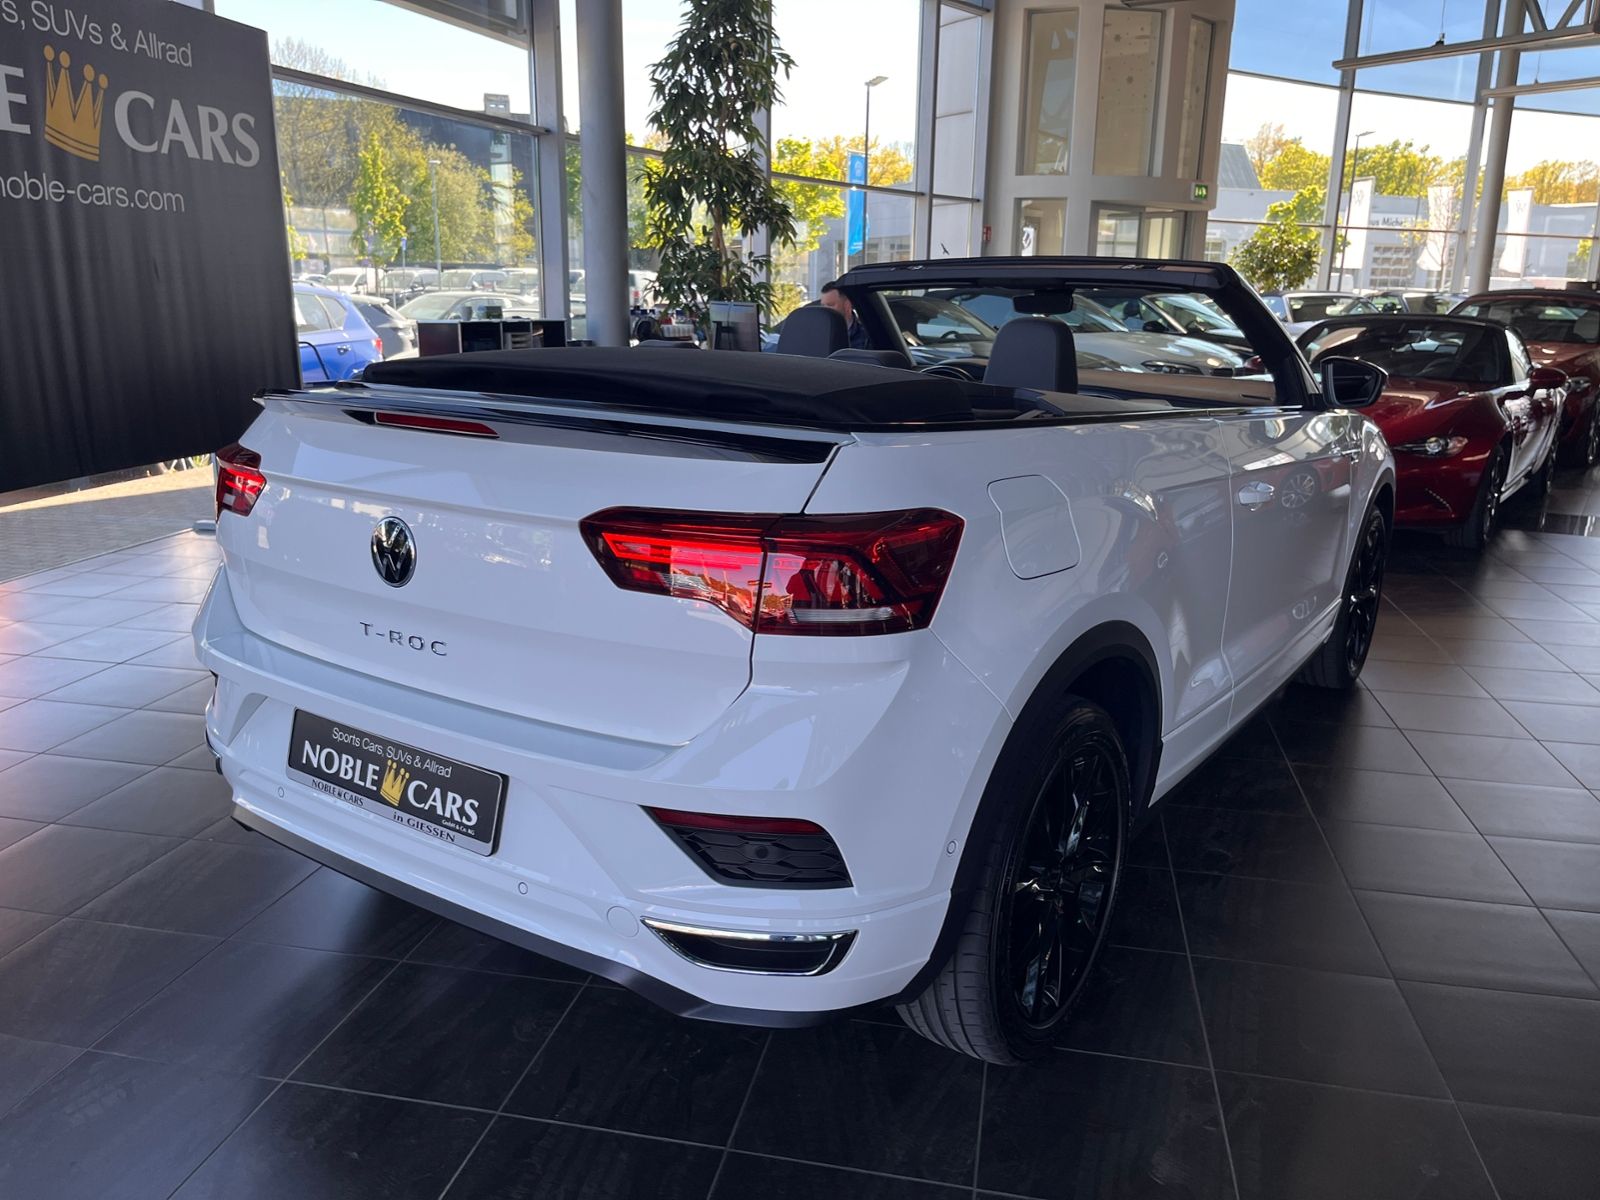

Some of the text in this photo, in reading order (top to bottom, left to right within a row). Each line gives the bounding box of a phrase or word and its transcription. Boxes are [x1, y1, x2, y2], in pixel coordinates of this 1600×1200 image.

[31, 0, 103, 45] SUVs
[110, 22, 129, 52] &
[134, 29, 192, 68] Allrad
[114, 90, 260, 168] CARS
[360, 621, 448, 656] T-ROC
[332, 727, 452, 778] Sports Cars, SUVs & Allrad
[302, 740, 479, 826] NOBLE CARS
[311, 779, 364, 808] NOBLE CARS
[393, 812, 456, 843] in GIESSEN
